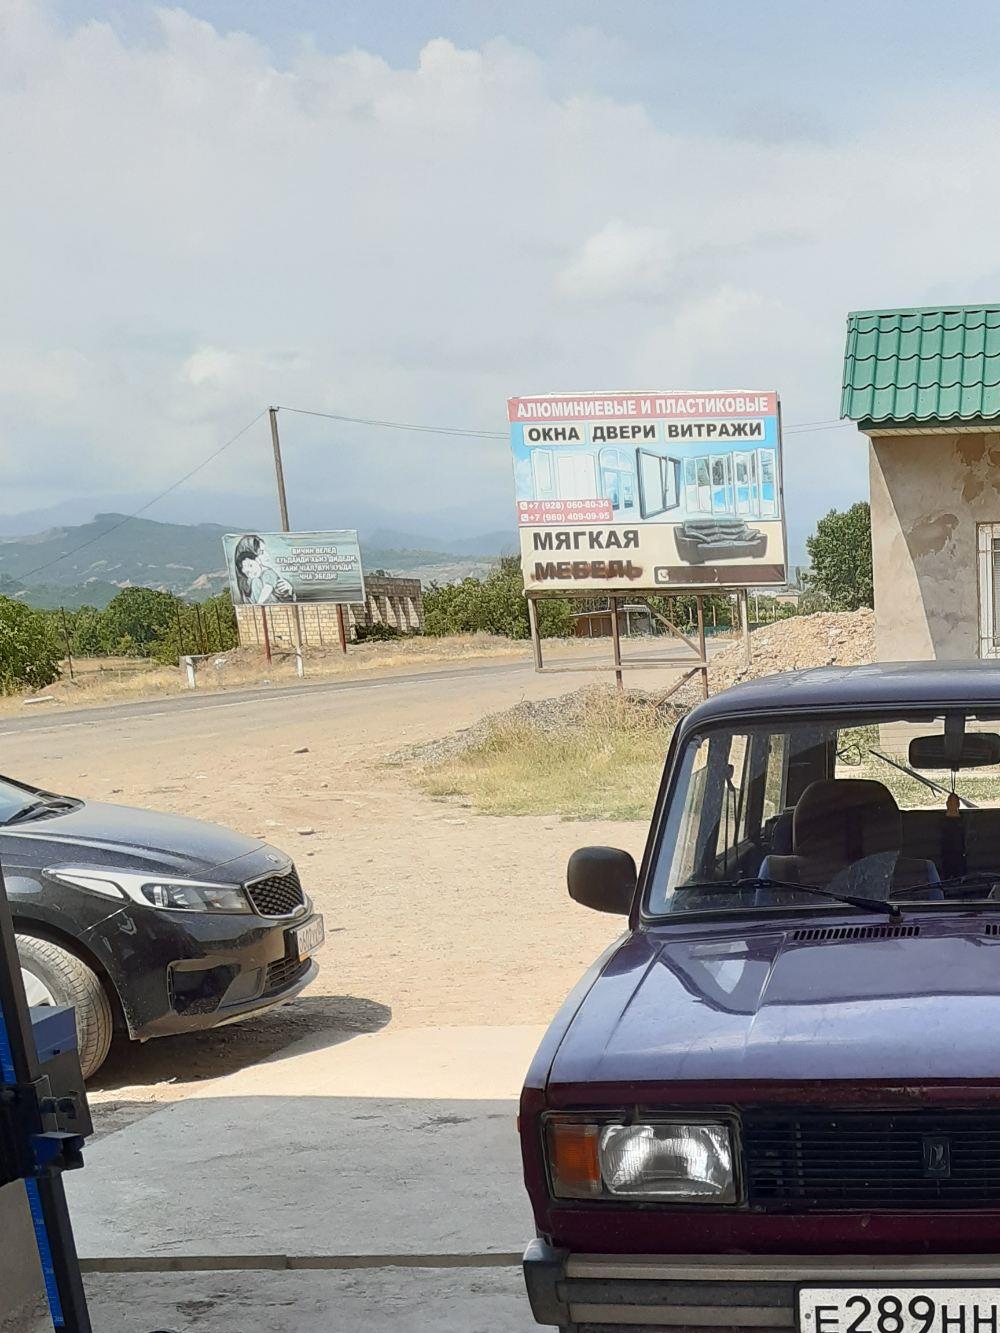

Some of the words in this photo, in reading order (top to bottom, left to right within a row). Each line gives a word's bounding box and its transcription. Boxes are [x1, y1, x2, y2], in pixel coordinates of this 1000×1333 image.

[517, 399, 637, 418] АЛЮМИНИЕВЫЕ
[641, 399, 651, 415] И
[655, 396, 769, 415] ПЛАСТИКОВЫЕ
[528, 427, 580, 442] ОКНА
[592, 424, 656, 442] ДВЕРИ
[667, 422, 762, 438] ВИТРАЖИ
[533, 529, 640, 551] МЯГКАЯ
[534, 560, 642, 580] МЕБЕЛЬ
